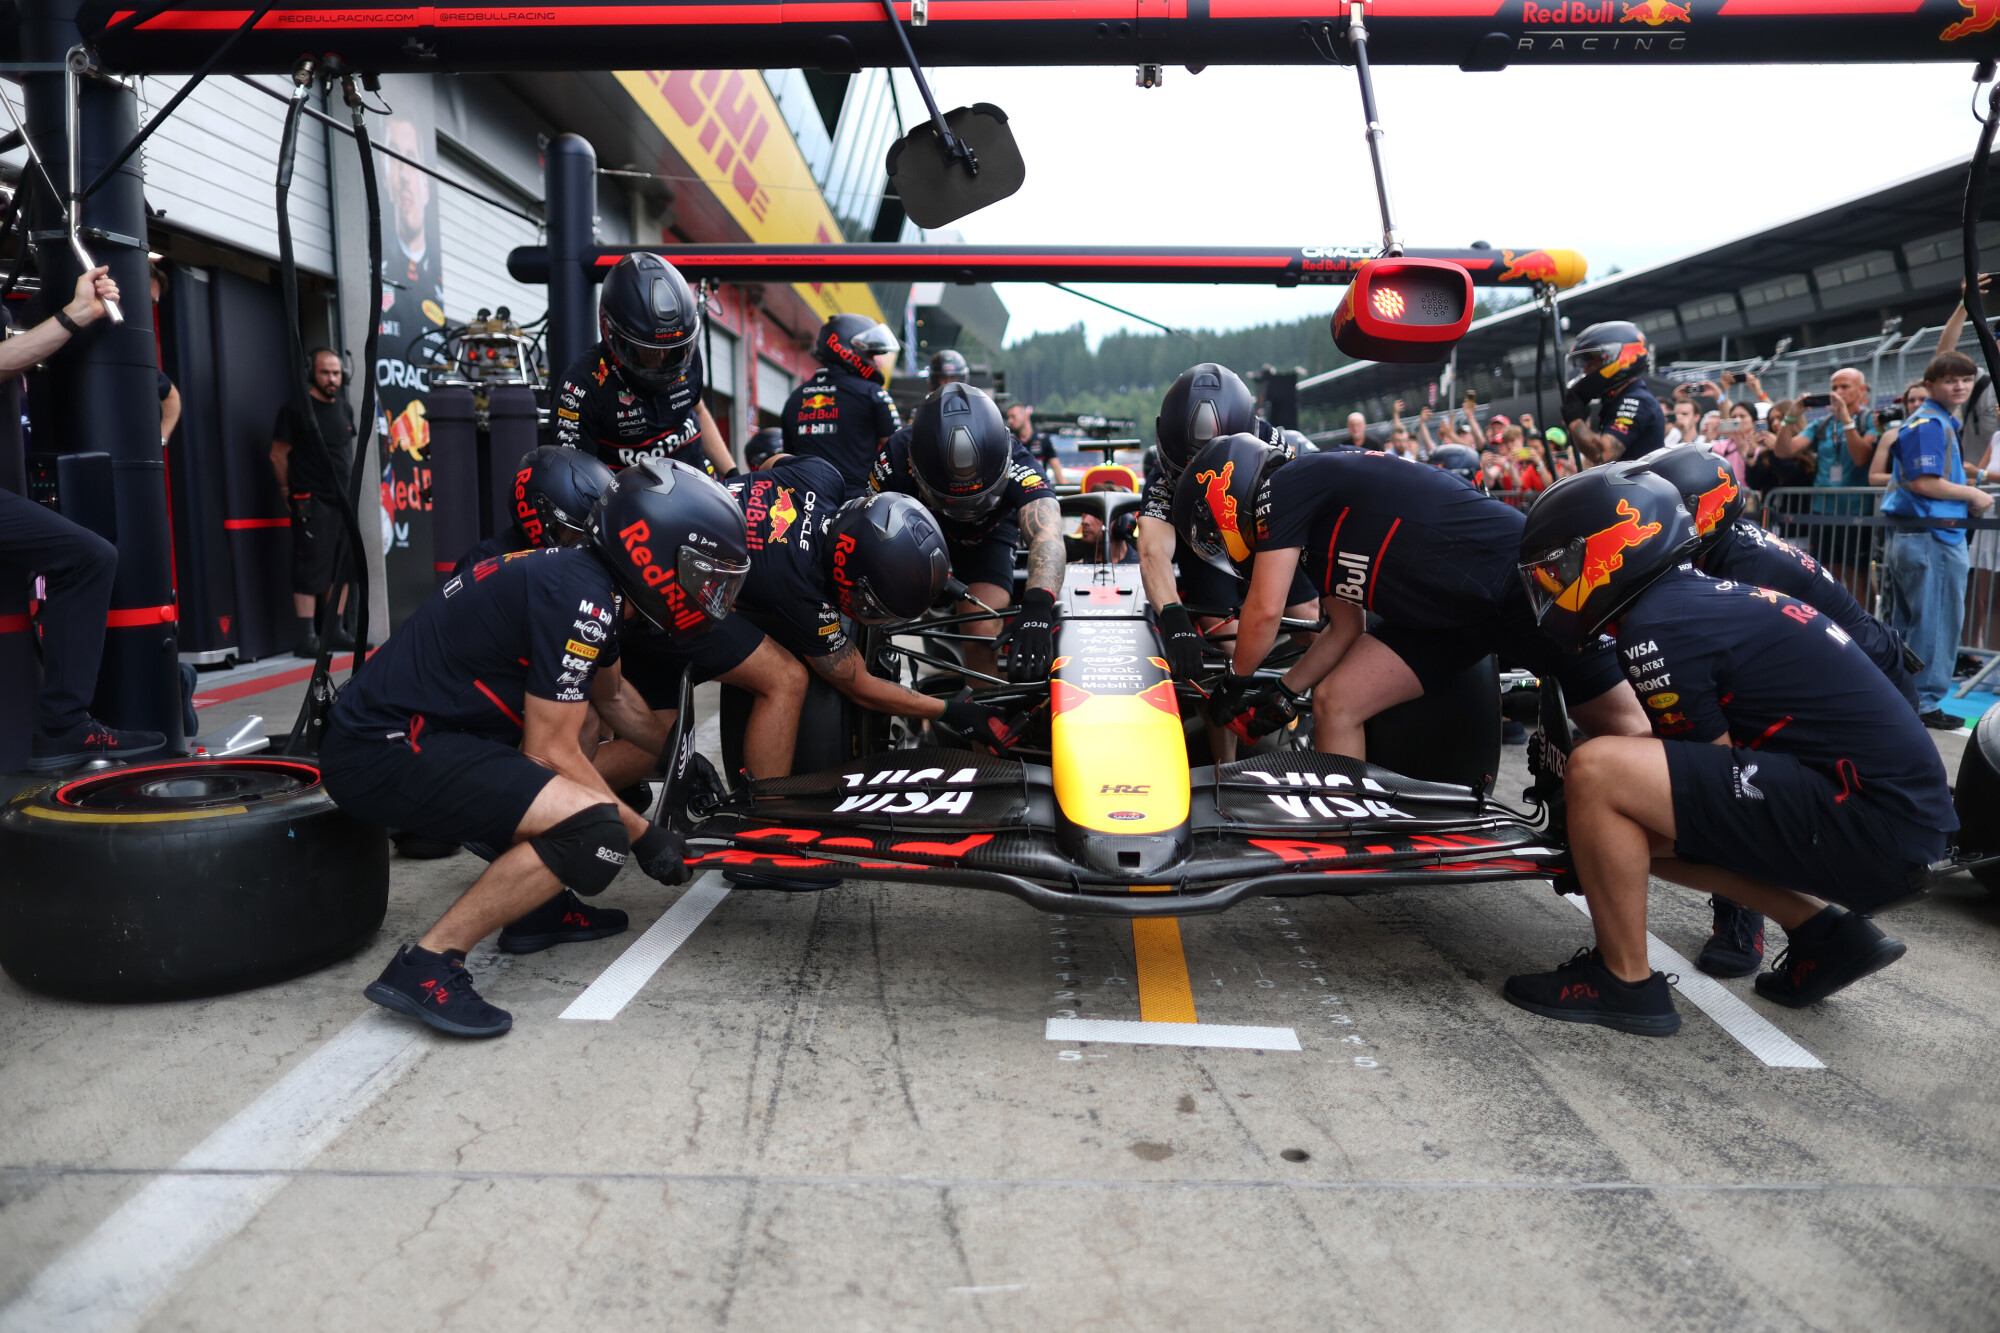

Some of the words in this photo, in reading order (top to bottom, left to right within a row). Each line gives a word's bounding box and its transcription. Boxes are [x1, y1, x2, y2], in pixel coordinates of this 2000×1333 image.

[279, 14, 414, 23] REDBULLRACING.COM
[439, 12, 555, 22] @REDBULLRACING
[1517, 38, 1686, 50] RACING
[655, 326, 683, 334] ORACLE
[563, 381, 587, 399] Mobil
[803, 385, 837, 394] ORACLE
[617, 408, 637, 419] Mobil
[618, 418, 646, 427] ORACLE
[798, 423, 825, 436] Mobil
[665, 418, 697, 455] Bull
[880, 452, 893, 475] Mobil
[515, 467, 537, 518] Red
[748, 480, 773, 511] Red
[800, 491, 815, 551] ORACLE
[1144, 511, 1167, 521] TRADE
[745, 508, 767, 551] Bull
[833, 533, 857, 586] Red
[619, 519, 676, 587] Red
[659, 577, 707, 631] Bull
[1335, 551, 1370, 600] Bull
[579, 600, 613, 626] Mobil
[573, 620, 594, 632] Hard
[590, 627, 607, 641] Rock
[569, 642, 597, 657] PIRELLI
[1624, 640, 1658, 660] VISA
[562, 654, 593, 671] HRC
[1642, 657, 1665, 673] AT&T
[1635, 673, 1670, 692] ROKT
[556, 693, 584, 701] TRADE
[84, 733, 118, 746] APL
[1100, 784, 1151, 793] HRC
[1054, 990, 1076, 999] 2
[1559, 984, 1599, 1001] APL
[1055, 1009, 1078, 1019] 3
[1329, 1014, 1352, 1023] 3
[1058, 1050, 1082, 1061] 5
[1354, 1056, 1379, 1067] 5
